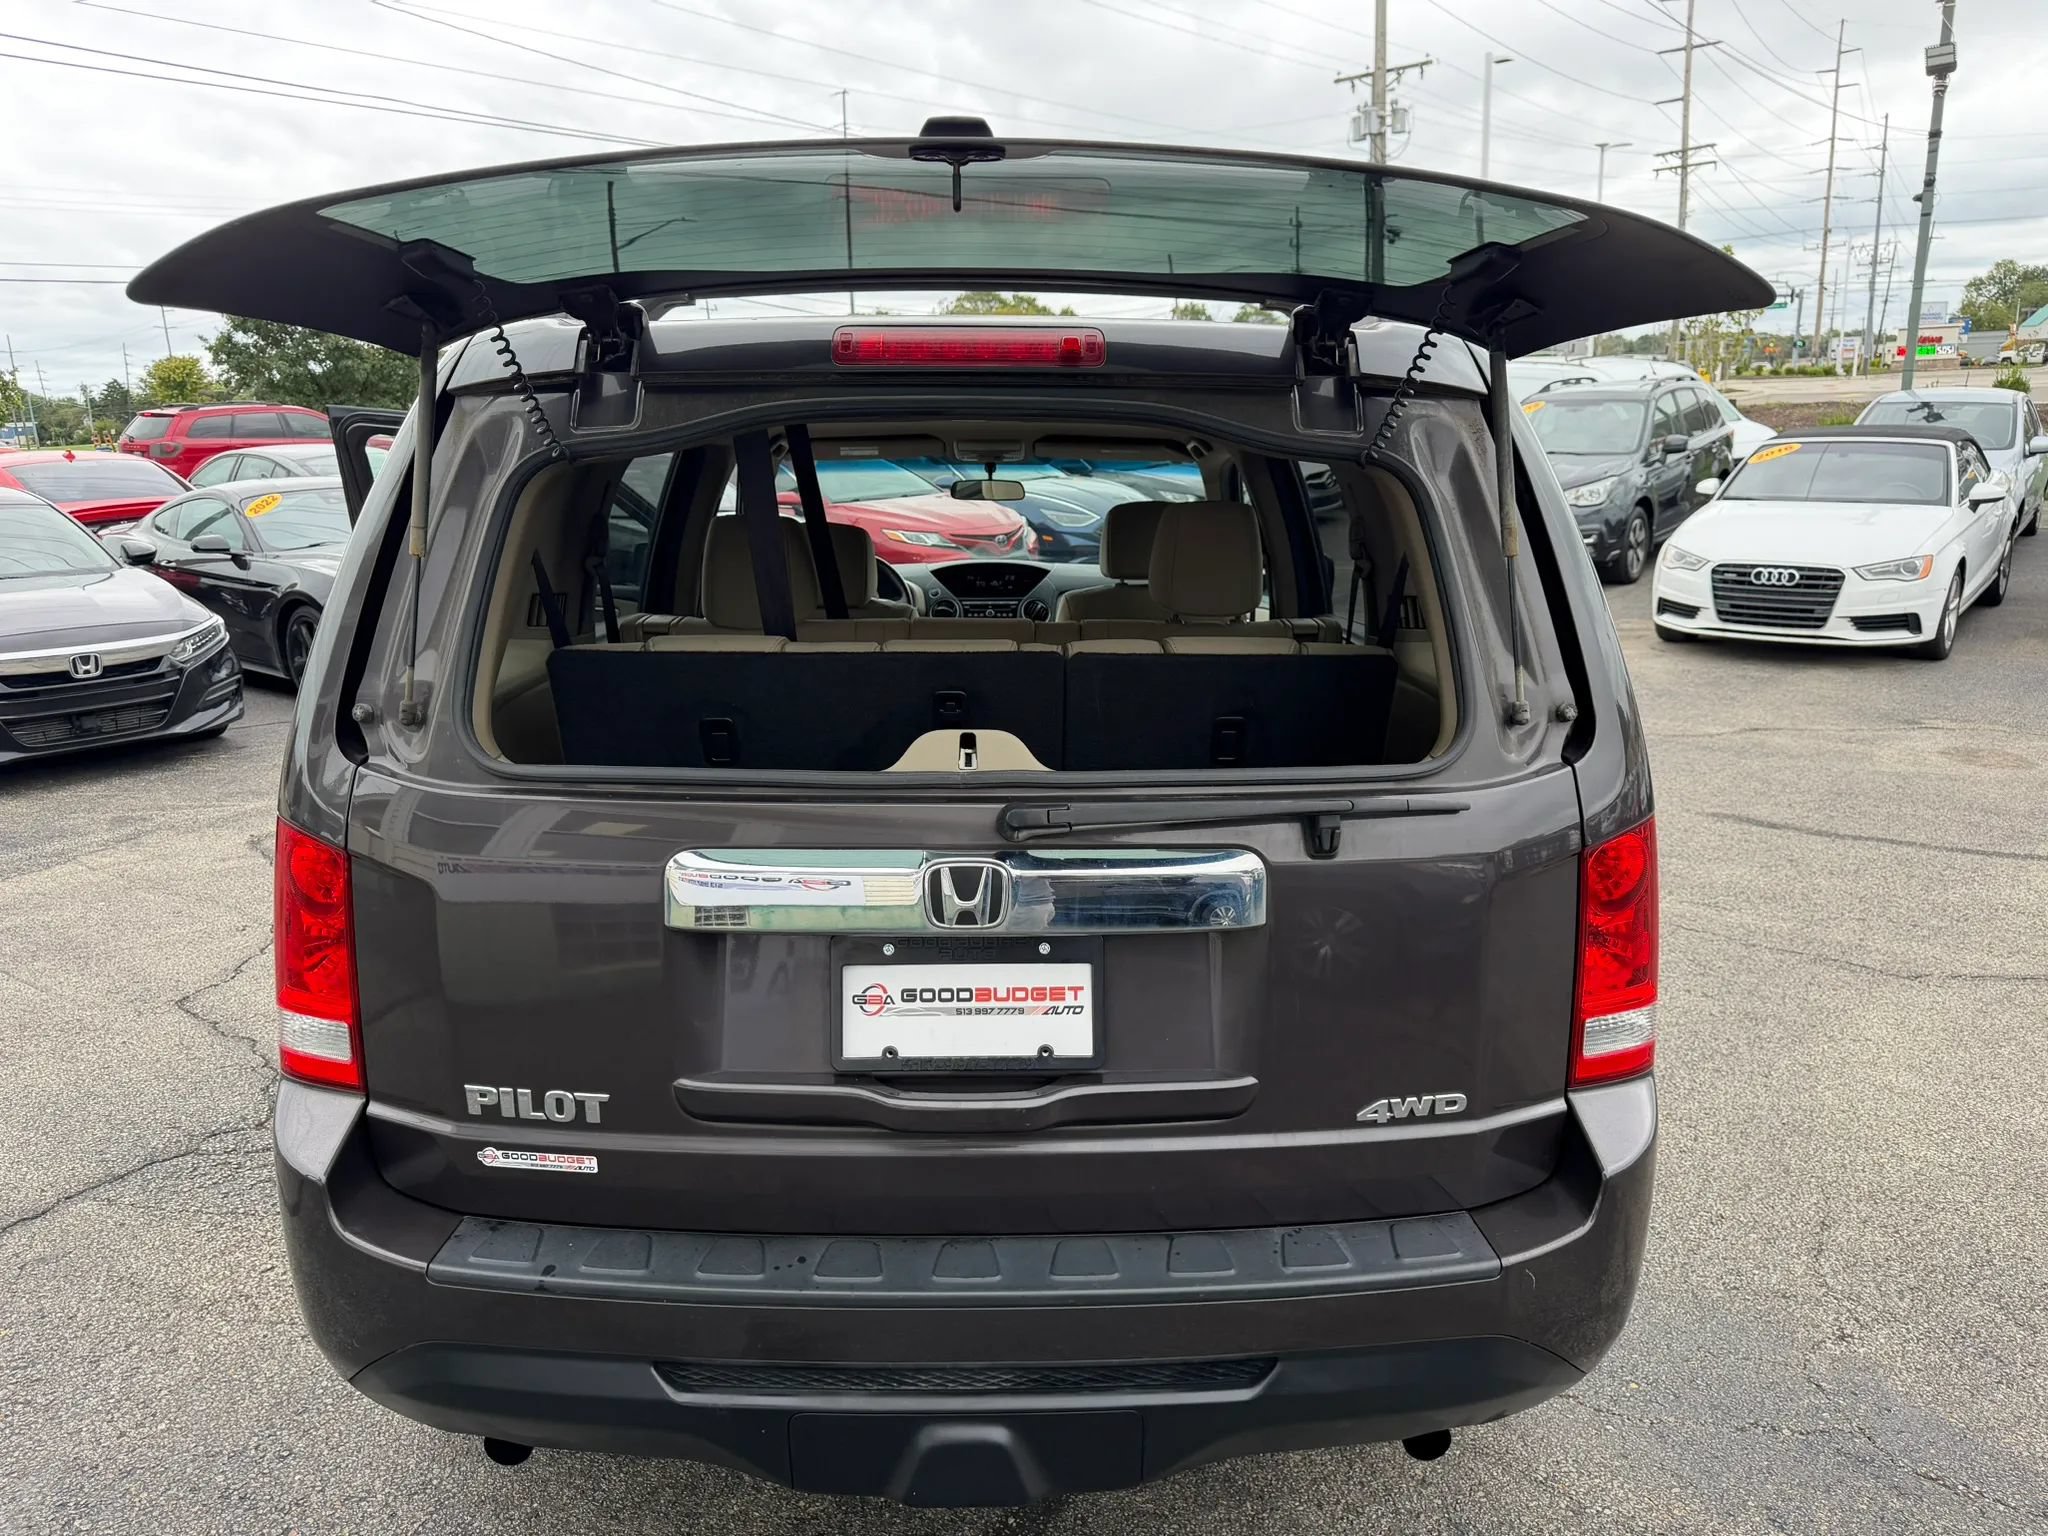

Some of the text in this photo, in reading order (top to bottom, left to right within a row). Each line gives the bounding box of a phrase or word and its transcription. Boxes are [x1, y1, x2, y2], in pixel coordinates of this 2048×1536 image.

[249, 495, 279, 515] 2022
[900, 986, 1085, 1003] GOODBUDGET
[1041, 1005, 1084, 1016] AUTO
[464, 1084, 611, 1124] PILOT
[1356, 1093, 1468, 1124] 4WD
[501, 1152, 595, 1165] GOODBUDGET
